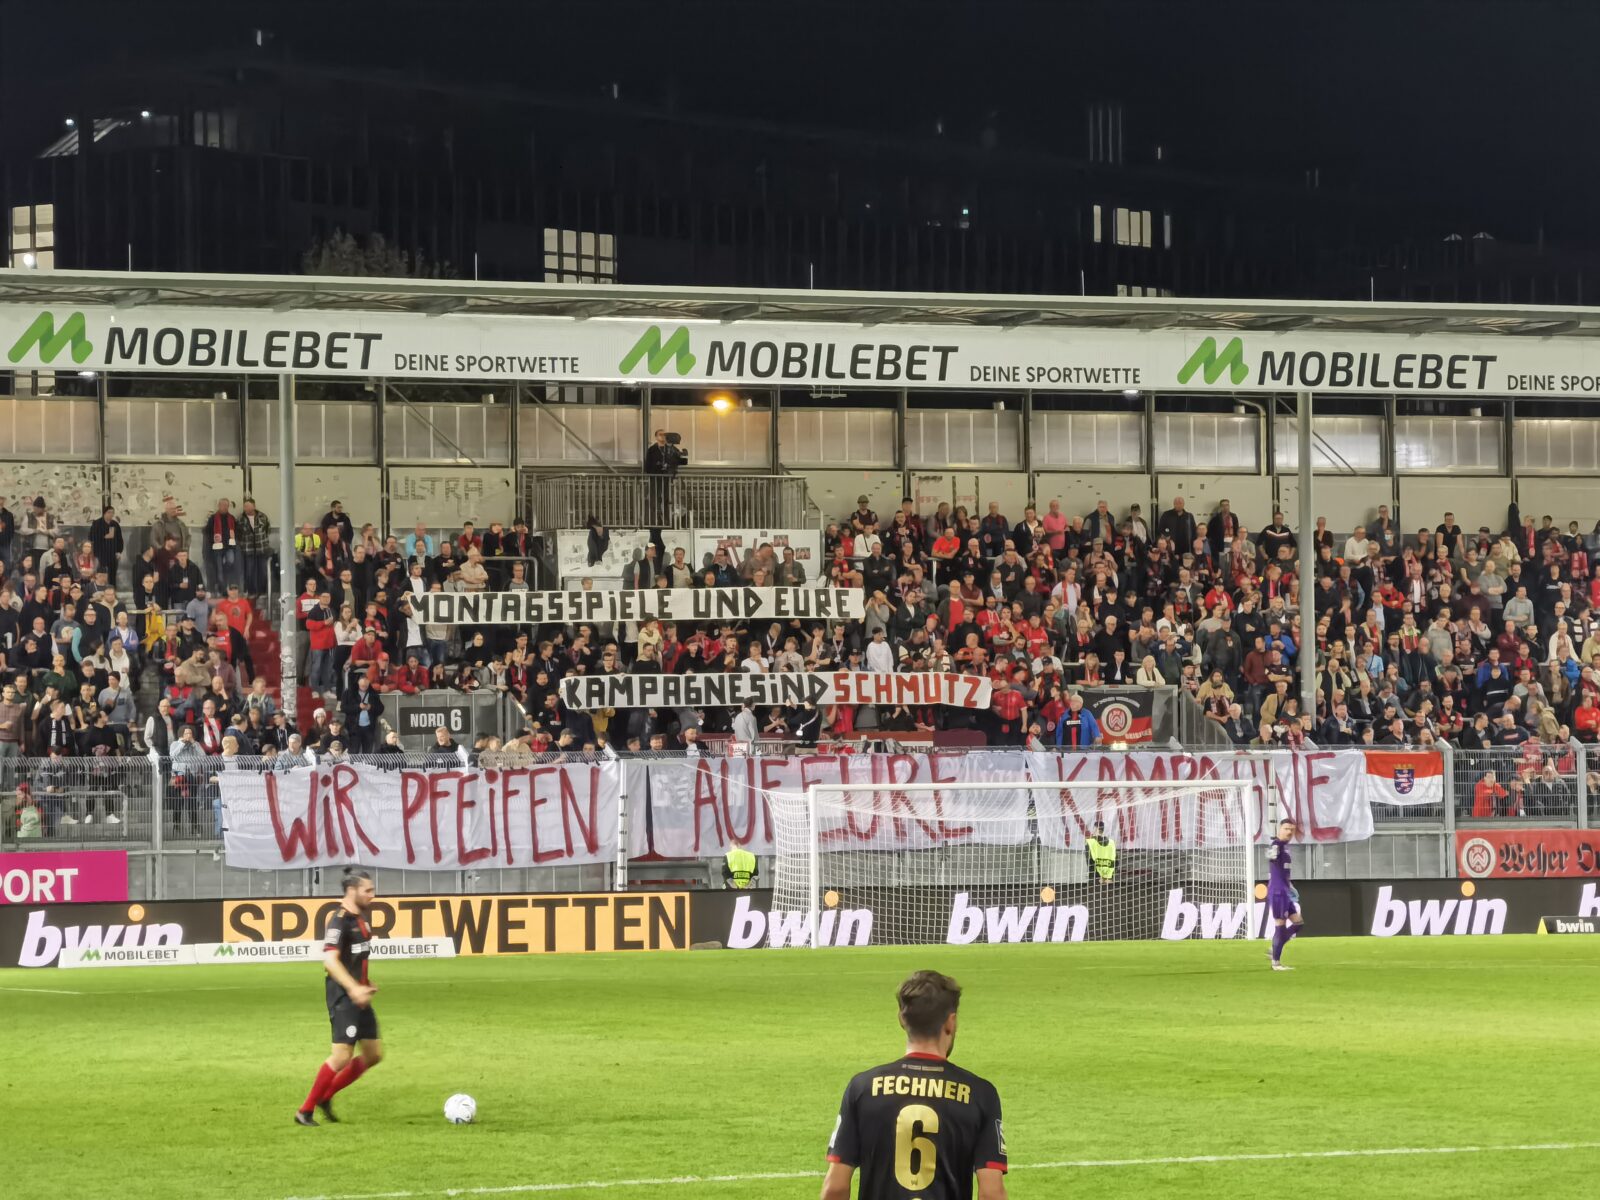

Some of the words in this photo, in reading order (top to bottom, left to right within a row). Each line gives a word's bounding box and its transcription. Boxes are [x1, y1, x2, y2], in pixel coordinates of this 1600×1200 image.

[103, 326, 383, 371] MOBILEBET
[394, 353, 449, 373] DEINE
[456, 354, 580, 375] SPORTWETTE
[705, 340, 959, 383] MOBILEBET
[970, 365, 1021, 384] DEINE
[1026, 366, 1141, 385] SPORTWETTE
[1257, 350, 1498, 390] MOBILEBET
[1507, 374, 1556, 391] DEINE
[693, 588, 763, 620] UND
[774, 587, 850, 619] EURE
[834, 673, 983, 709] SCHMUTZ
[410, 713, 445, 728] NORD
[450, 708, 462, 731] 6
[693, 758, 789, 853] AUF
[0, 868, 78, 902] ORT
[727, 889, 874, 949] bwin
[946, 887, 1090, 945] bwin
[1370, 880, 1508, 937] bwin
[1556, 918, 1594, 933] bwin
[104, 949, 179, 961] MOBILEBET
[237, 945, 310, 957] MOBILEBET
[369, 944, 439, 955] MOBILEBET
[872, 1075, 971, 1104] FECHNER
[895, 1105, 939, 1191] 6
